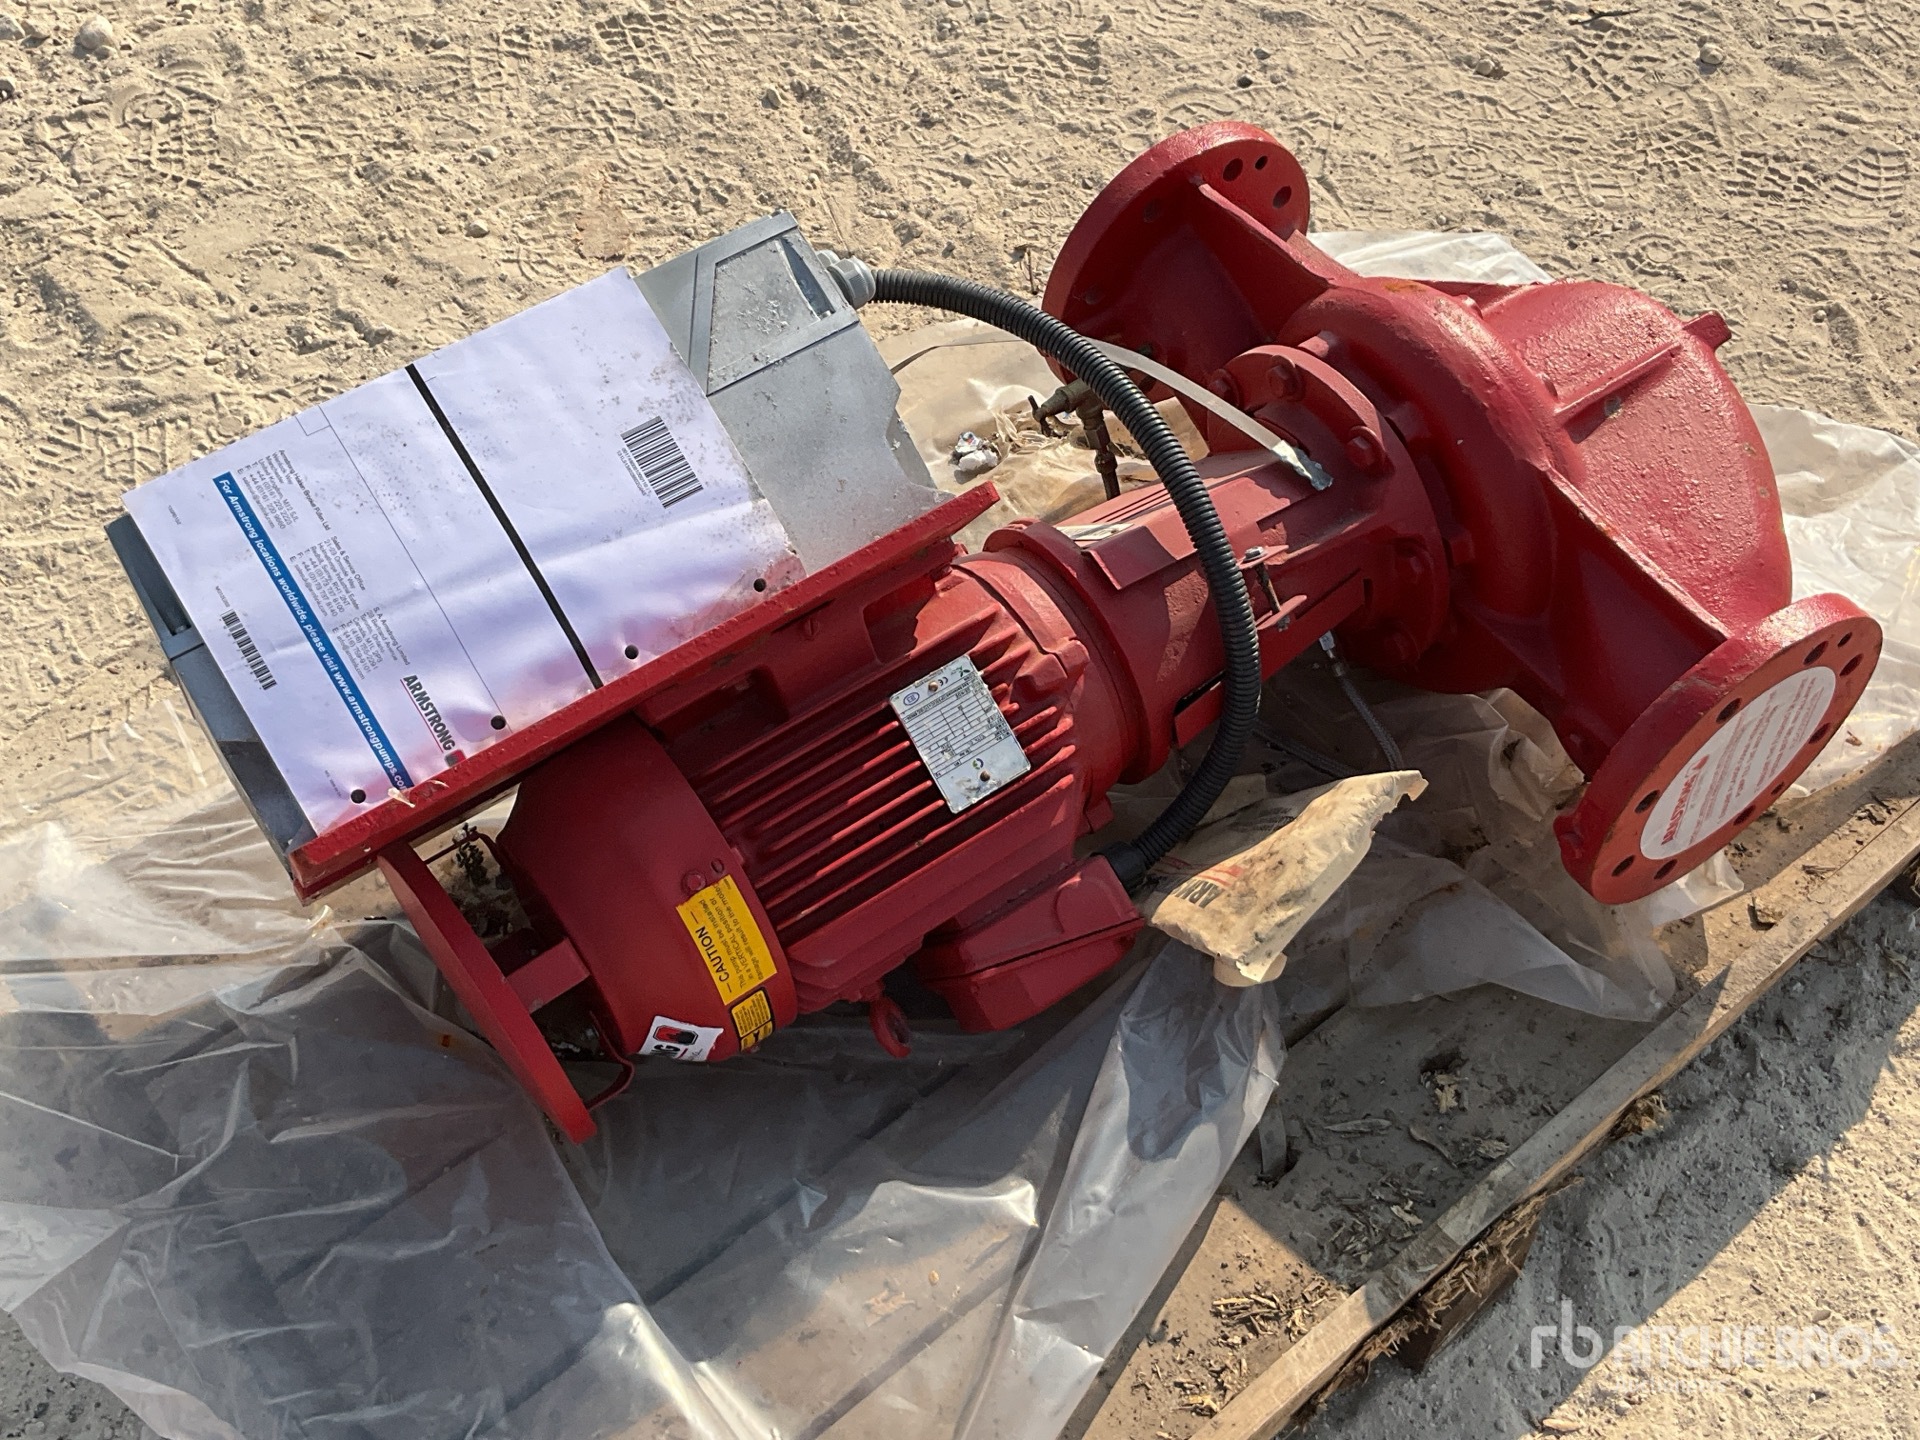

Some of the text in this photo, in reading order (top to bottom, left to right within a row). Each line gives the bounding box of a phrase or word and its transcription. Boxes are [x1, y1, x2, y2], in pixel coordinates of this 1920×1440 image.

[258, 459, 270, 475] United
[266, 456, 284, 483] Manchester
[279, 450, 295, 474] Armstrong
[250, 474, 259, 484] +44
[257, 471, 266, 481] +44
[302, 562, 311, 571] +44
[309, 558, 318, 568] +44
[331, 536, 341, 550] Sales
[343, 555, 355, 574] Service
[354, 574, 365, 590] Office
[219, 480, 232, 493] For
[228, 496, 258, 538] Armstrong
[255, 539, 281, 577] locations
[278, 578, 307, 623] worldwide,
[303, 624, 325, 652] please
[323, 653, 338, 671] visit
[336, 573, 350, 594] Industrial
[347, 578, 355, 589] Way
[381, 620, 399, 646] Armstrong
[396, 645, 410, 665] Limited
[403, 675, 455, 750] ARMSTRONG
[709, 897, 717, 905] or
[698, 899, 718, 928] installed
[715, 906, 733, 933] position
[726, 906, 735, 918] the
[716, 929, 724, 939] be
[736, 926, 748, 945] result
[695, 926, 729, 982] CAUTION
[721, 939, 732, 955] must
[729, 933, 748, 968] VERTICAL
[730, 956, 742, 974] pump
